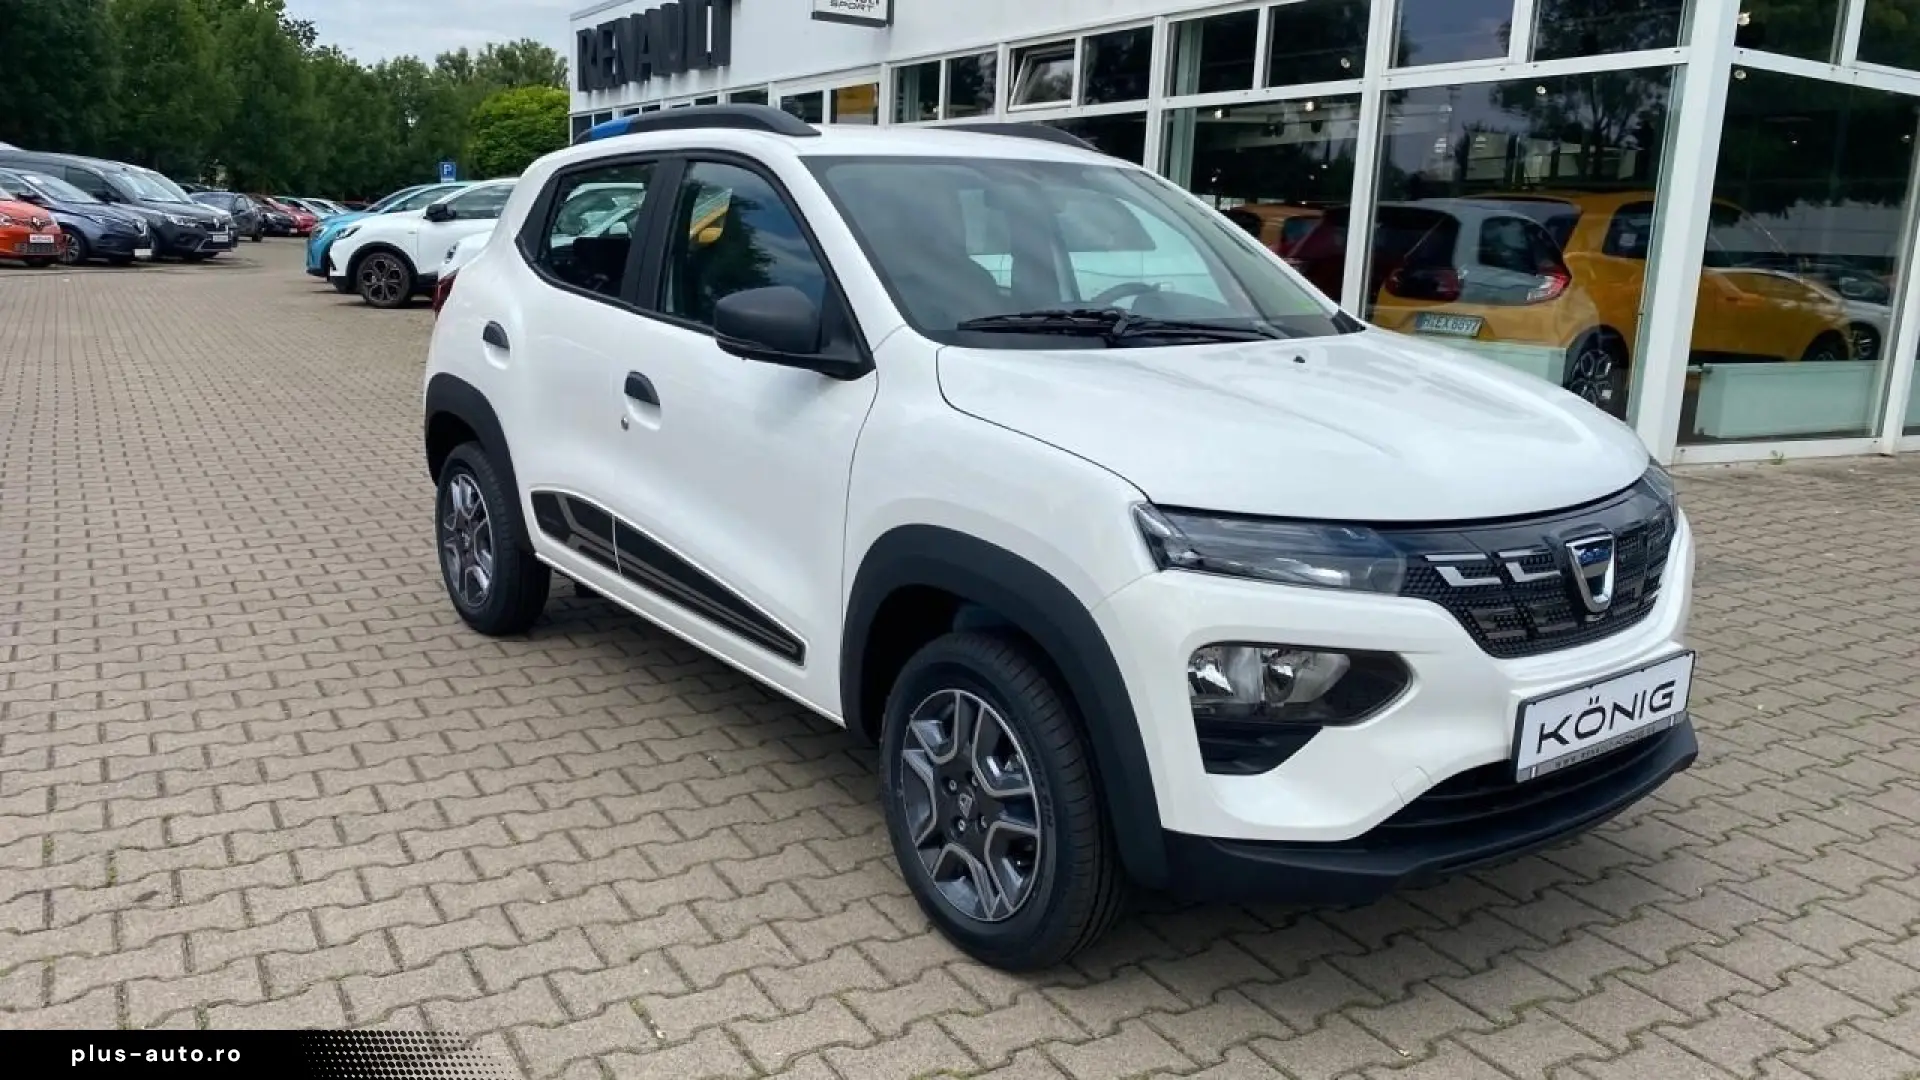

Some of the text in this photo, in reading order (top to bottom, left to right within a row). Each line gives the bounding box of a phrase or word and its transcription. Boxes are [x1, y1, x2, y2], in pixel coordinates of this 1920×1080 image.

[830, 0, 875, 13] SPORT
[576, 0, 732, 92] RENAULT
[1536, 679, 1676, 754] KÖNIG
